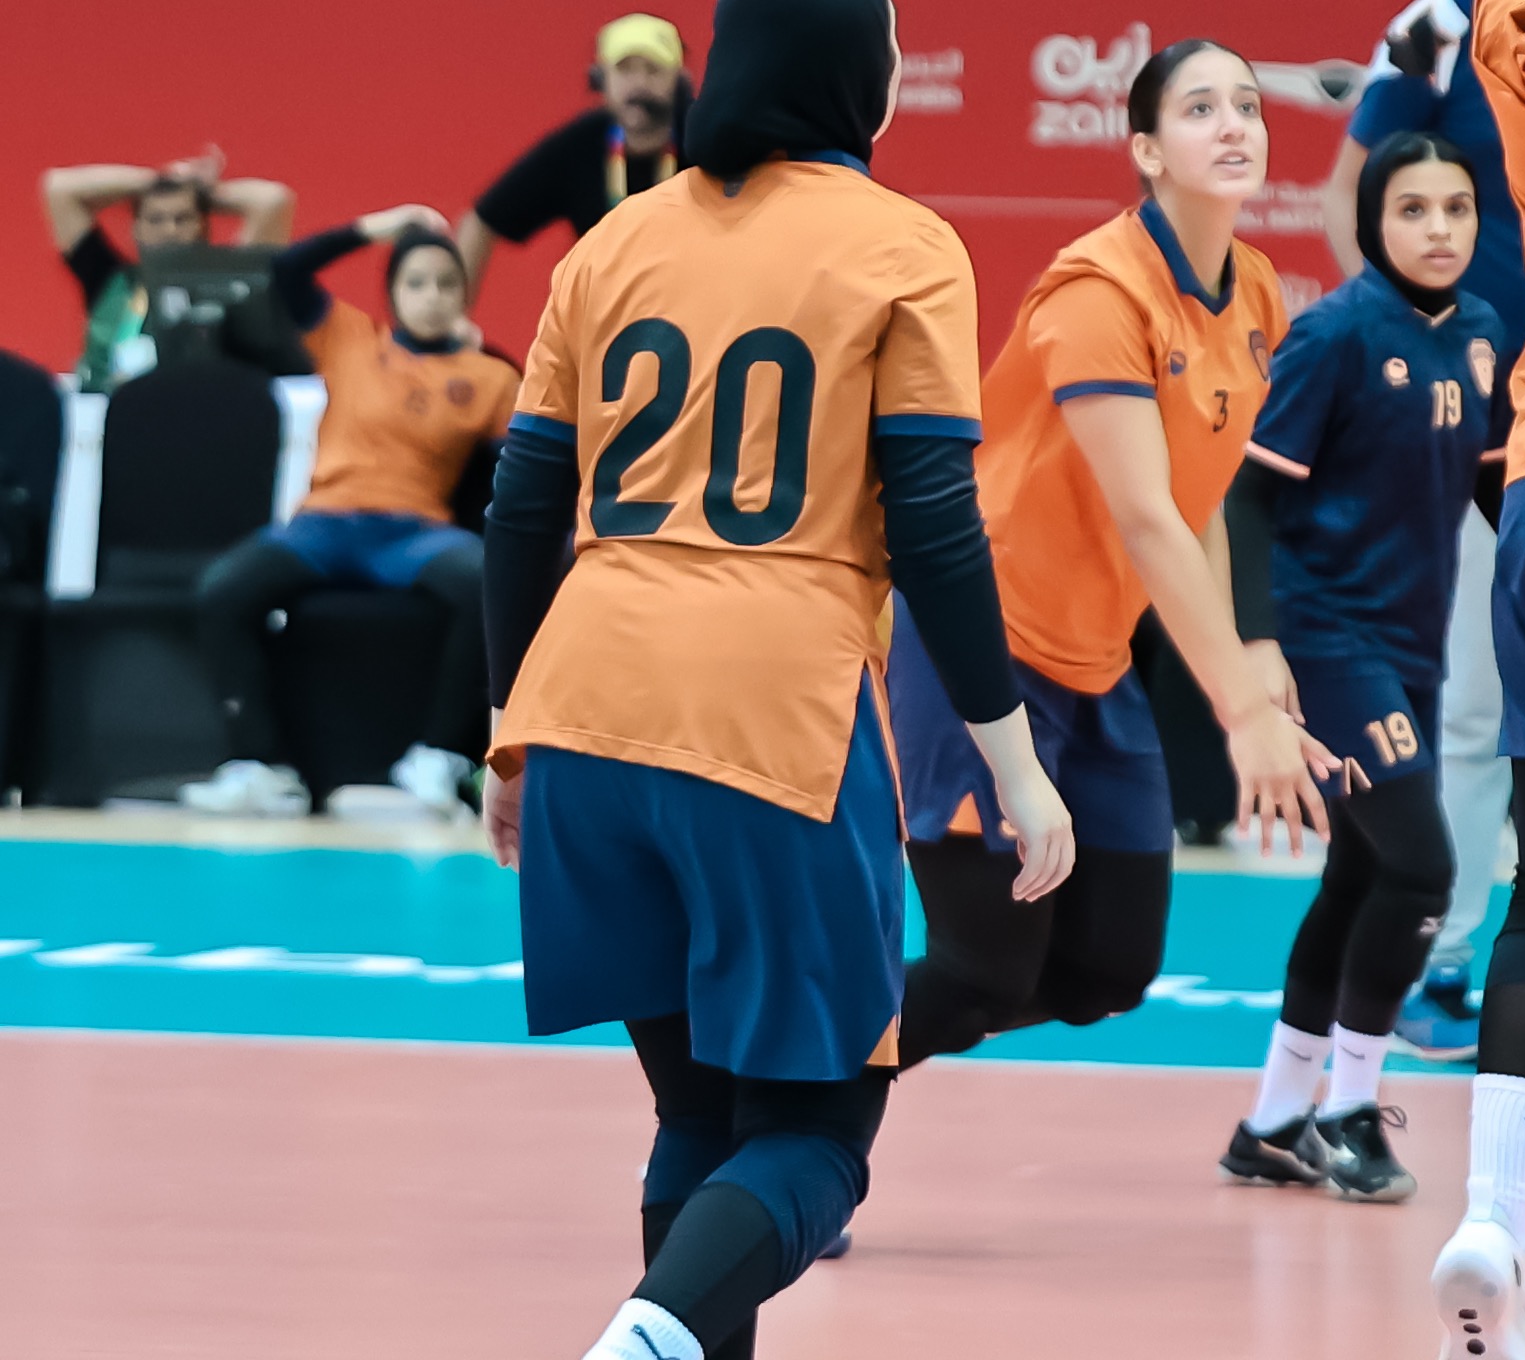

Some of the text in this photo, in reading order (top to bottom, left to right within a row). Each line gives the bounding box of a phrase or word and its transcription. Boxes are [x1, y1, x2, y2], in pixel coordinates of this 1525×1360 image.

[589, 317, 816, 546] 20
[1212, 389, 1229, 433] 3
[1430, 379, 1463, 430] 19
[1365, 711, 1420, 768] 19
